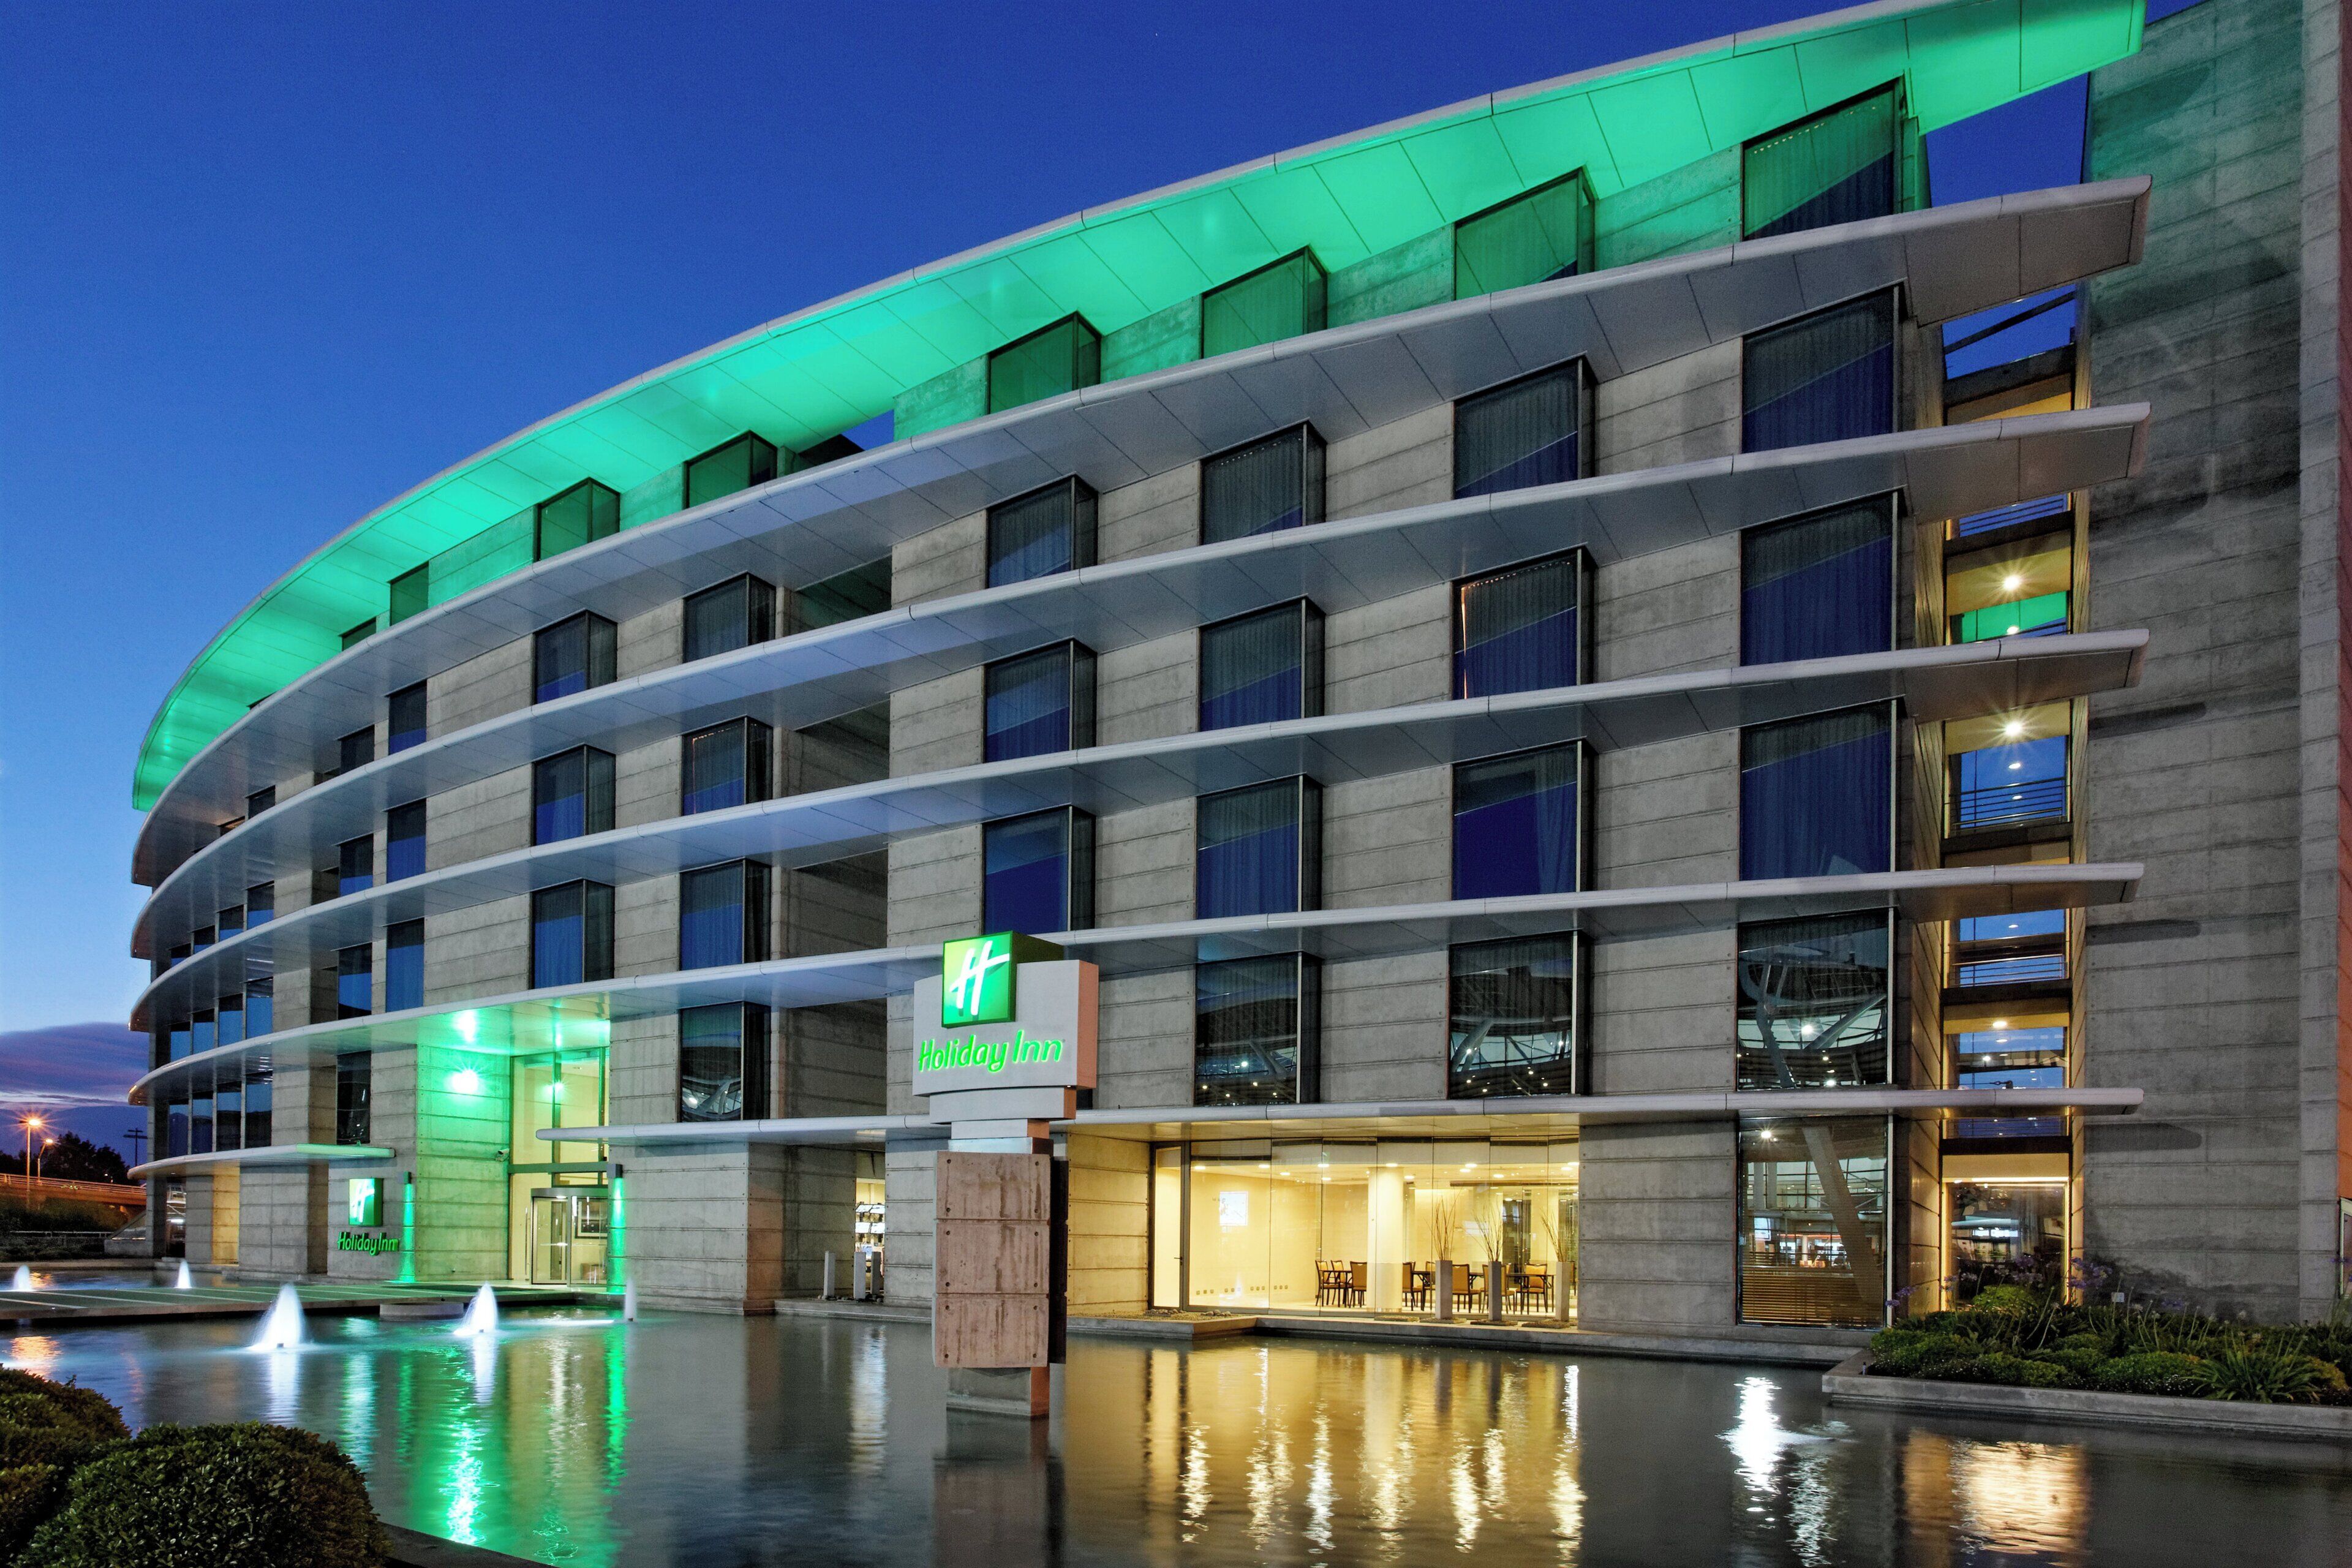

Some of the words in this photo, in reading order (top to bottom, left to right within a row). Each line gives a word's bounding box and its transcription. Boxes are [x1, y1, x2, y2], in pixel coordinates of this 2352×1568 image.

[918, 1034, 1009, 1073] Holiday
[1012, 1029, 1063, 1063] Inn
[337, 1232, 379, 1256] Holiday
[379, 1232, 399, 1251] Inn
